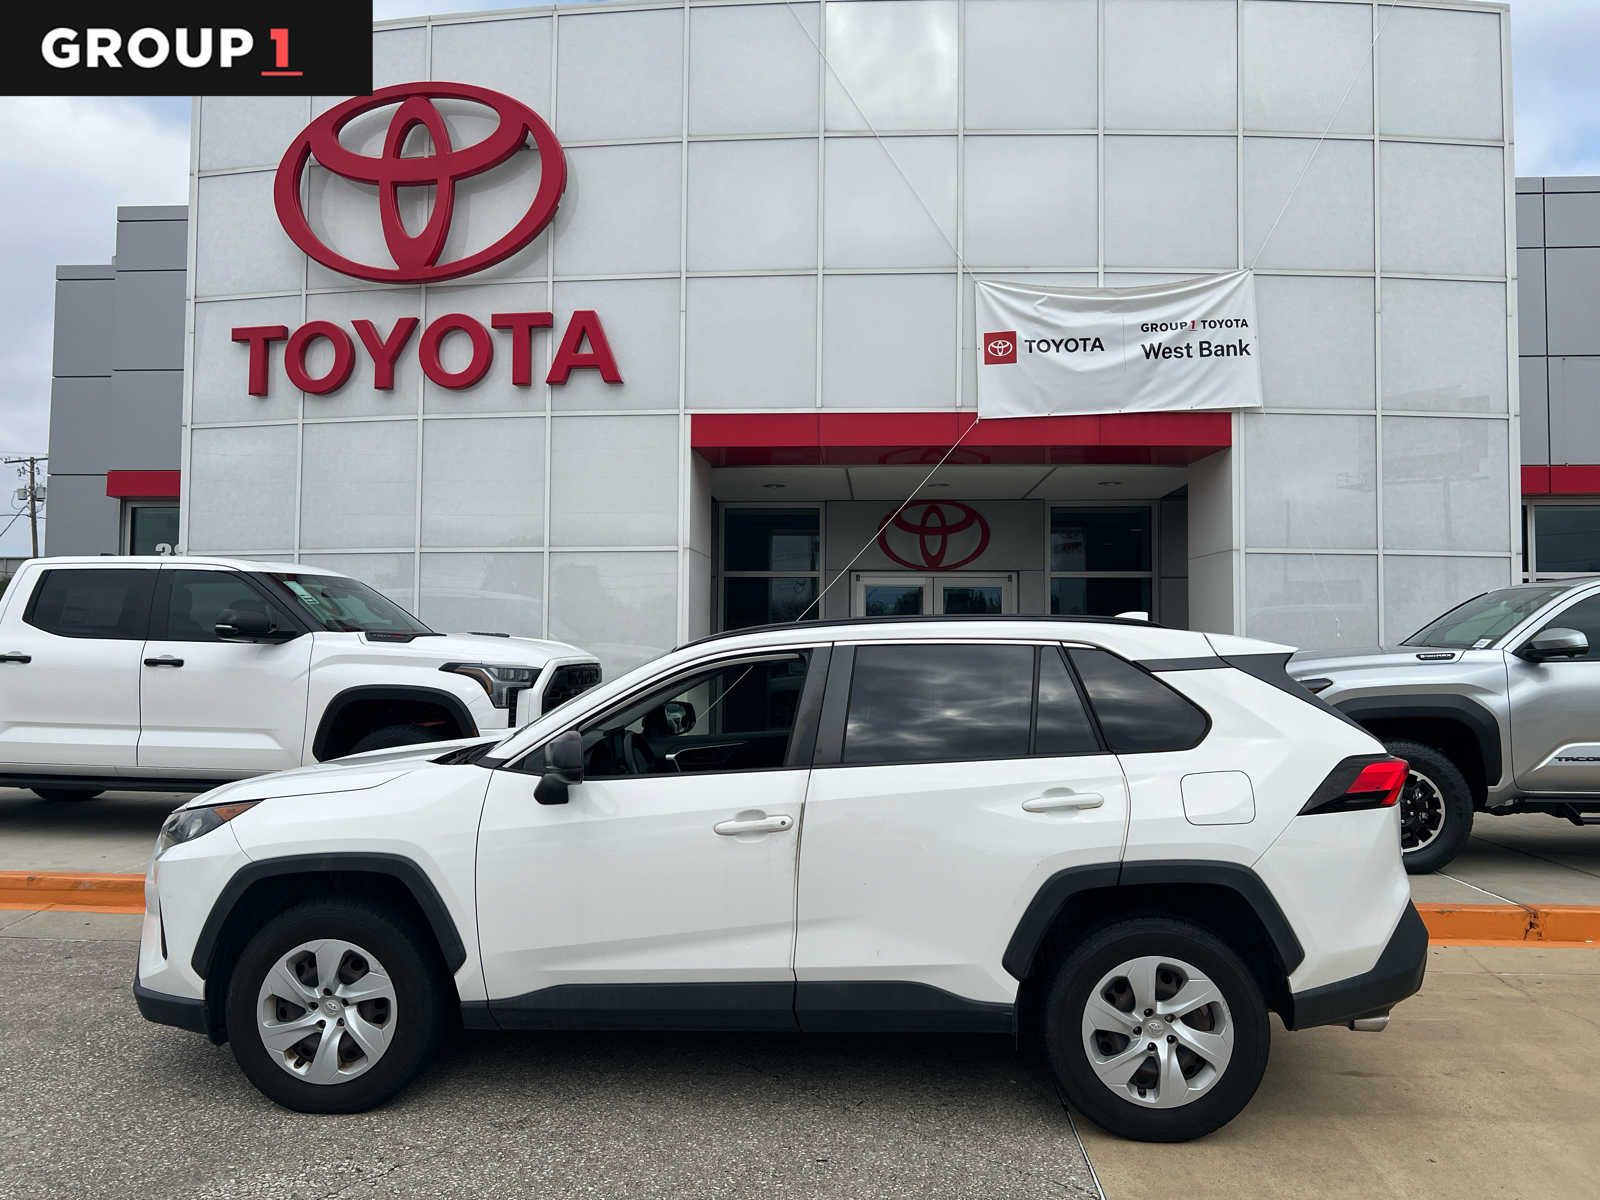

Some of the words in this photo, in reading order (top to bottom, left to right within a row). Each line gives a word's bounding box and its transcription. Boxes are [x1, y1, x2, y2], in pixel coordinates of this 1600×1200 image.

[1140, 321, 1188, 333] GROUP
[1201, 318, 1249, 330] TOYOTA
[231, 310, 624, 397] TOYOTA
[1024, 337, 1105, 354] TOYOTA
[1141, 341, 1193, 360] West
[1199, 339, 1251, 358] Bank
